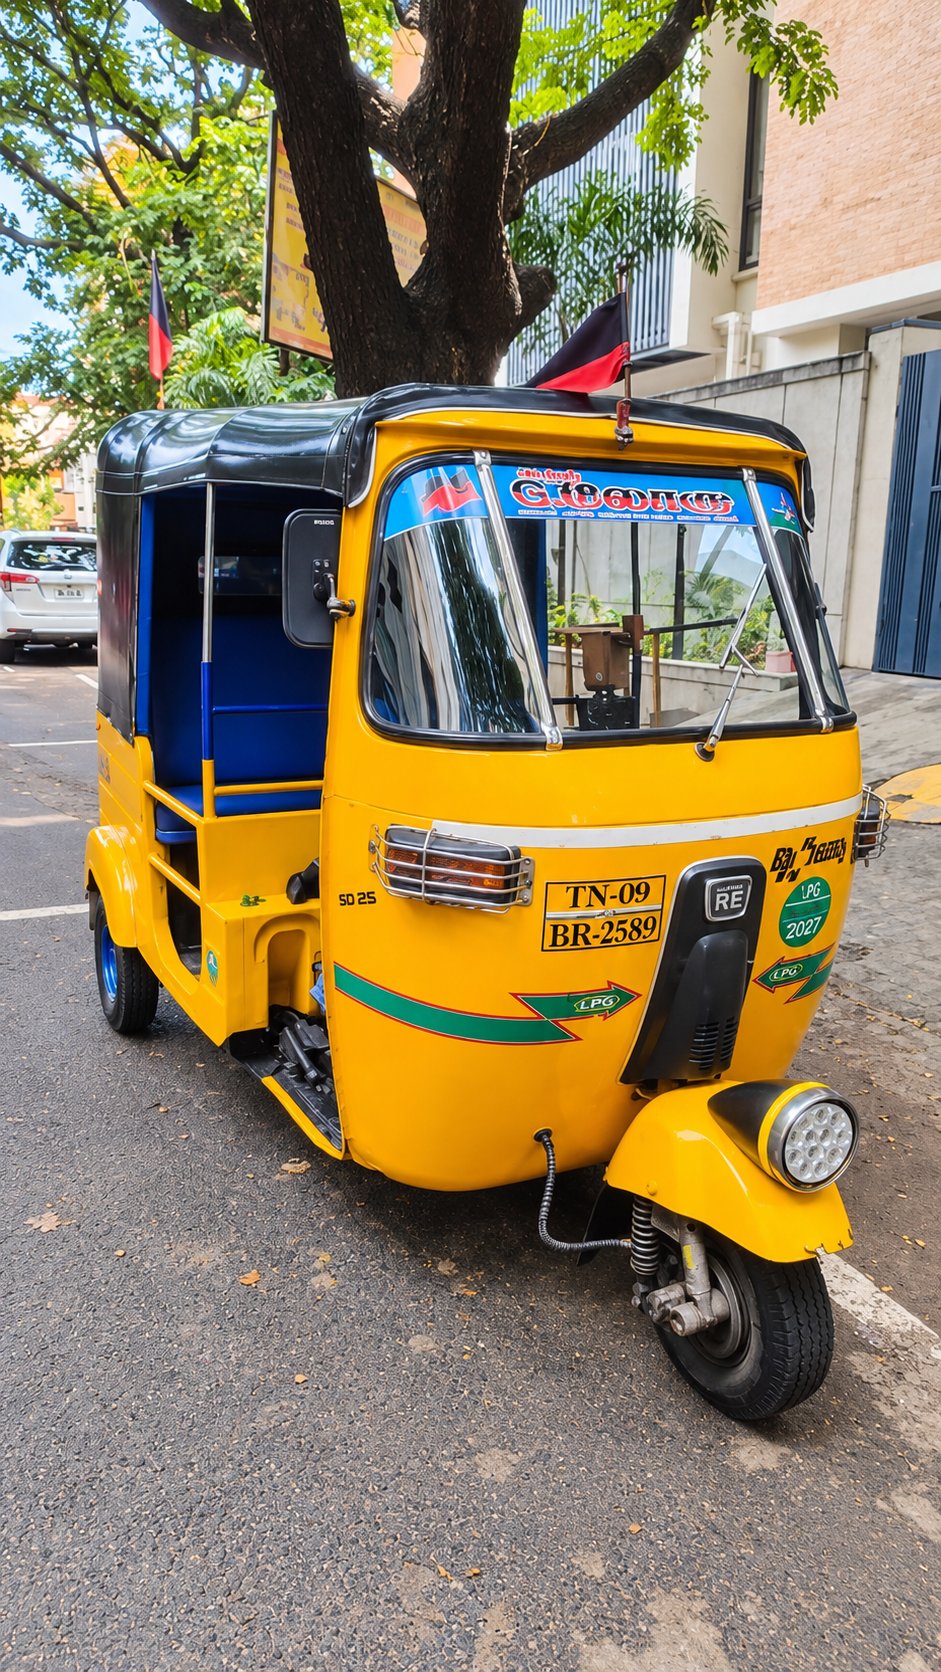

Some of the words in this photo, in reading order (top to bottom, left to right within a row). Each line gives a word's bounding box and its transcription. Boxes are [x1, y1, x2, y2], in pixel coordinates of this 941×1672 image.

[338, 893, 355, 906] SD
[357, 891, 377, 905] 25
[565, 881, 651, 909] TN-09
[714, 890, 744, 912] RE
[801, 881, 821, 899] LPG
[548, 915, 658, 948] BR-2589
[785, 916, 822, 940] 2027
[579, 994, 617, 1010] LPG
